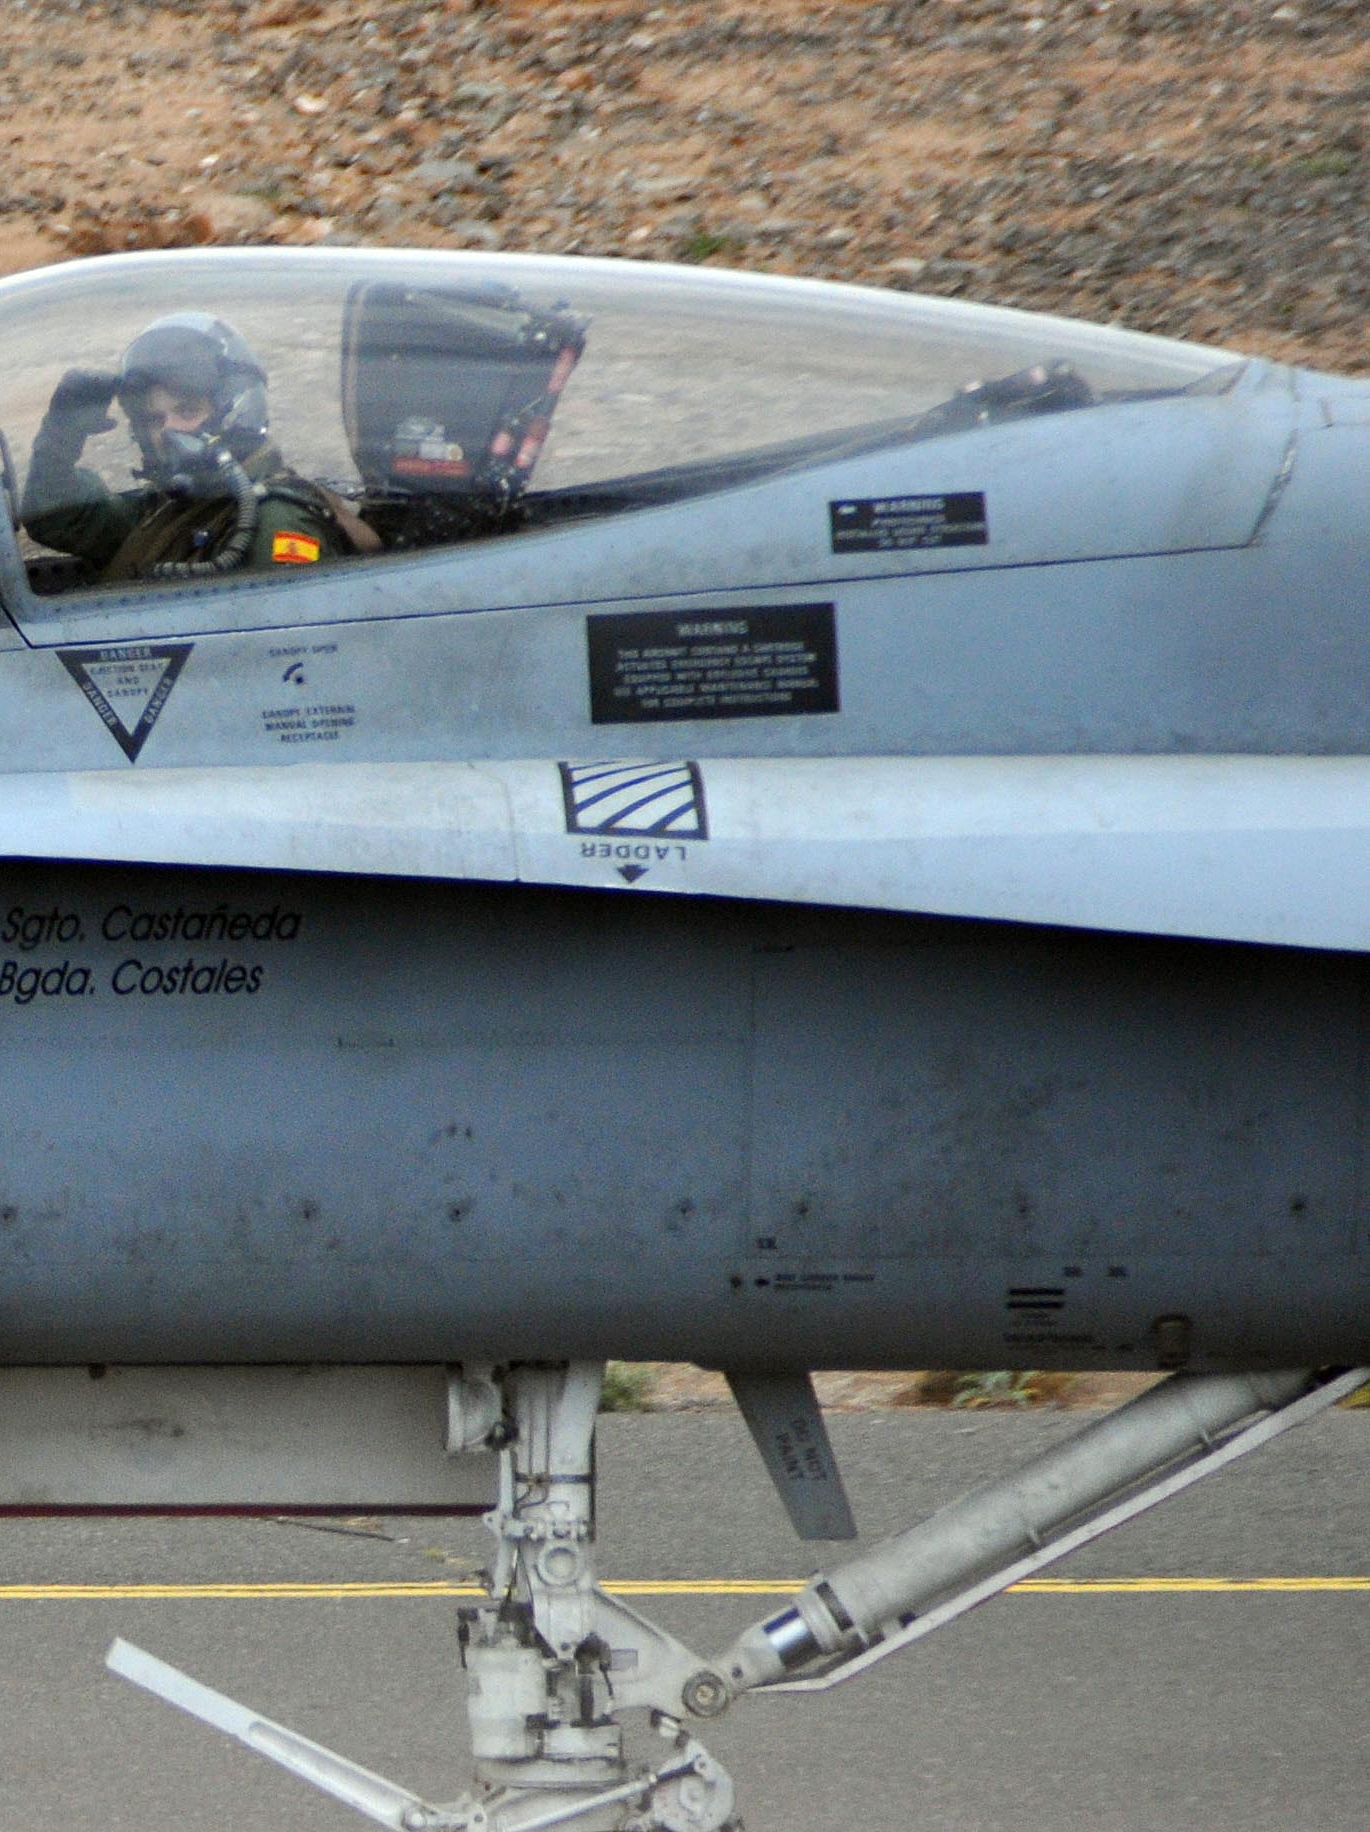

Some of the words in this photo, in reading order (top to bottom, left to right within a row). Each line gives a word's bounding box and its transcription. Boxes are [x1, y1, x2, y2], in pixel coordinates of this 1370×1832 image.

[100, 646, 152, 660] DANGER
[580, 842, 687, 861] LADDER
[1, 906, 85, 950] Sgto.
[102, 903, 302, 942] Castañeda
[111, 958, 264, 995] Costales
